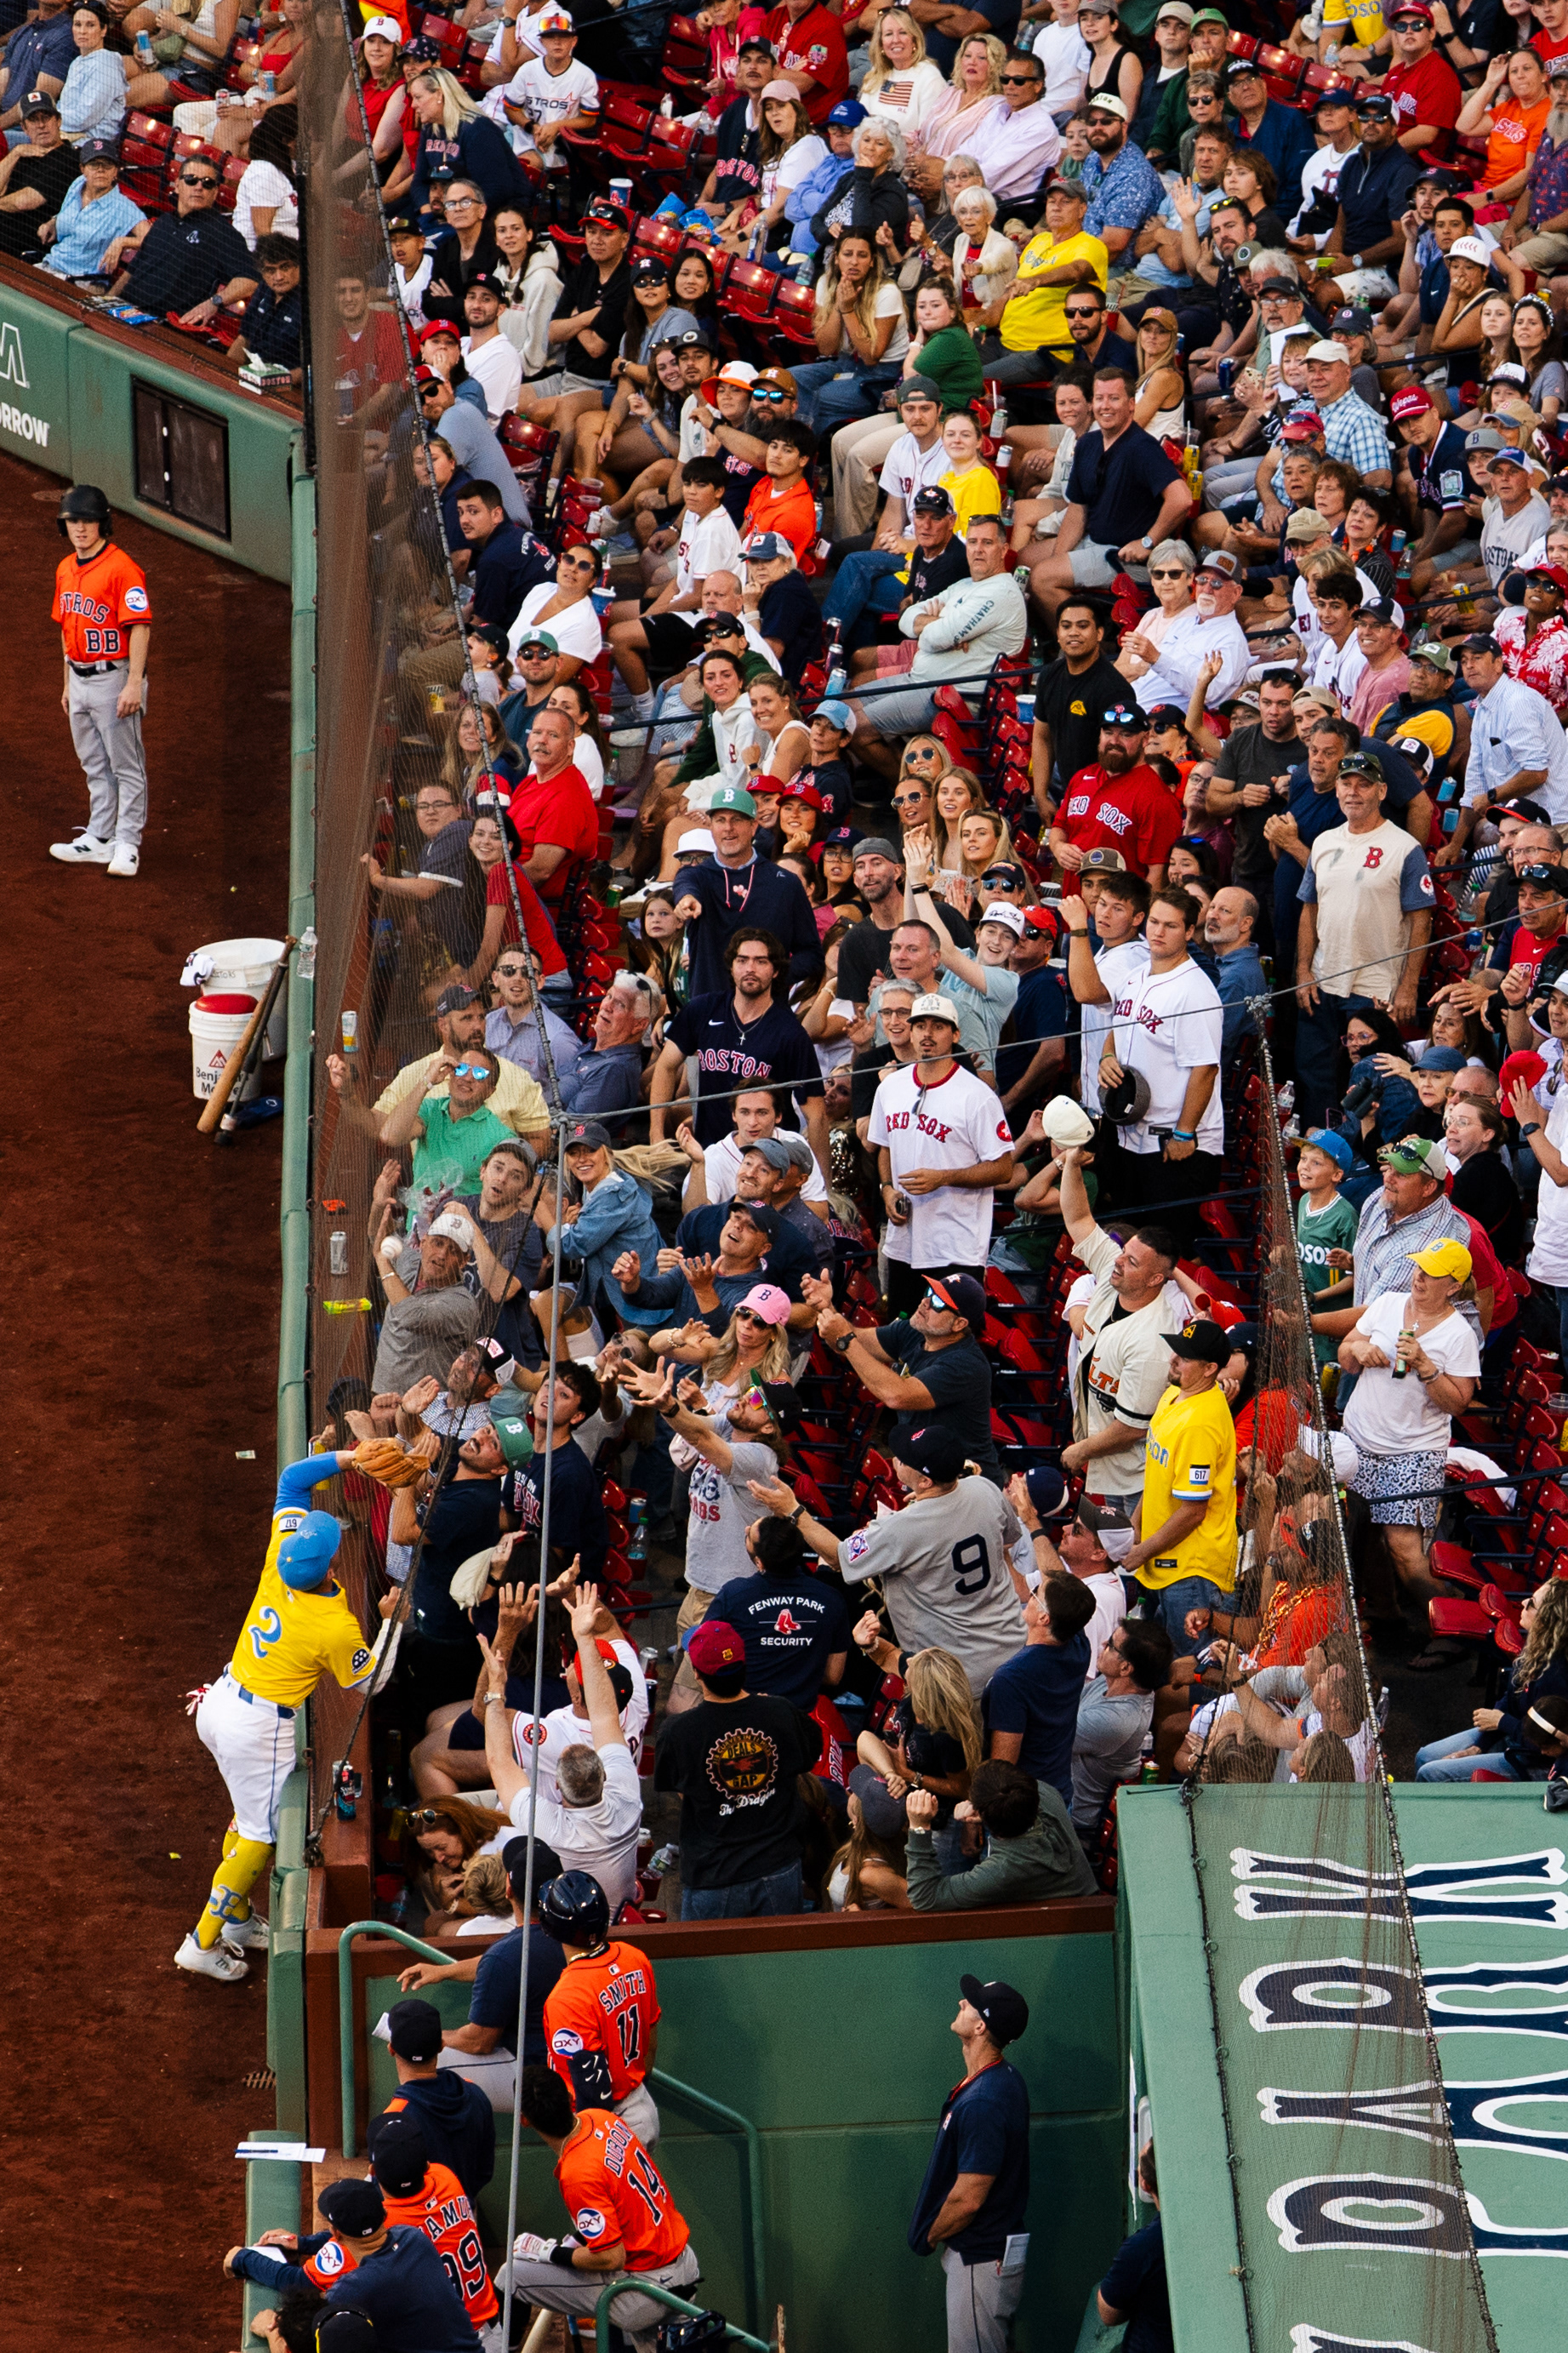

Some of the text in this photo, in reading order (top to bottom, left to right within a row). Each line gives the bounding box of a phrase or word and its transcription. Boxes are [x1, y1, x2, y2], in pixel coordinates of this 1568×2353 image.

[526, 95, 568, 109] STROS
[0, 402, 50, 448] RROW
[1472, 432, 1480, 444] B
[60, 592, 110, 625] TROS
[85, 629, 120, 654] BB
[529, 630, 541, 641] B
[722, 788, 734, 802] B
[1067, 795, 1132, 836] ED SOX
[837, 826, 850, 838] B
[1363, 847, 1383, 868] B
[1136, 1006, 1163, 1034] SOX
[886, 1111, 952, 1143] RED SOX
[758, 1289, 771, 1301] B
[505, 1422, 523, 1435] B
[1195, 1471, 1206, 1480] 617
[951, 1533, 991, 1596] 9
[748, 1596, 825, 1615] FENWAY PARK
[248, 1606, 282, 1659] 2
[760, 1636, 813, 1648] SECURITY
[727, 1742, 757, 1758] DEALS
[732, 1774, 758, 1789] GAP
[599, 1969, 647, 2015] SMITH
[554, 2037, 580, 2047] OXY
[616, 2003, 640, 2069] 11
[1229, 1847, 1568, 2260] PARK
[627, 2147, 666, 2227] 14
[419, 2195, 476, 2241] AMU
[579, 2215, 602, 2230] OXY
[321, 2246, 341, 2270] OXY
